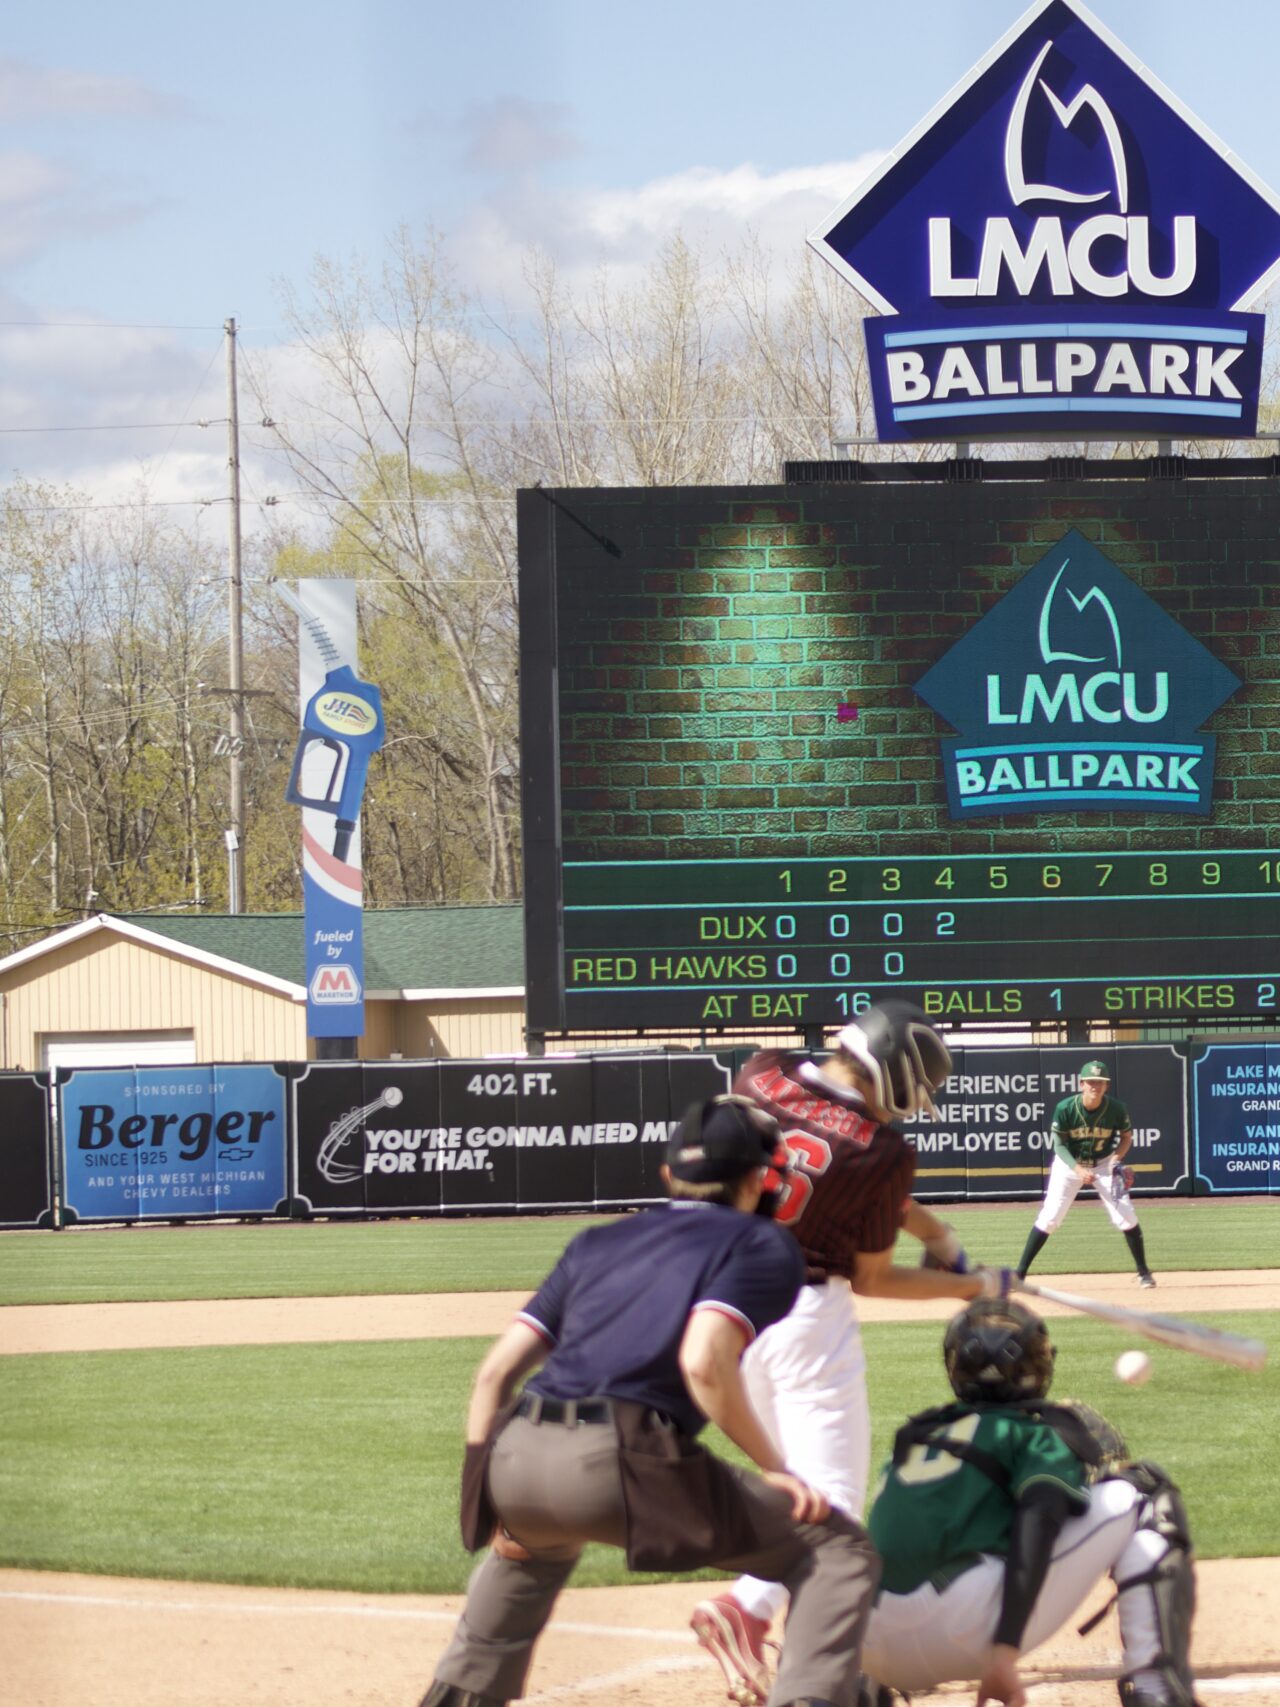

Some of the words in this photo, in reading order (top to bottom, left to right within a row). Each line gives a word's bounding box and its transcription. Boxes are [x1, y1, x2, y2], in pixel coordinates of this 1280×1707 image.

[928, 214, 1197, 297] LMCU
[886, 342, 1244, 403] BALLPARK
[986, 671, 1169, 724] LMCU
[956, 754, 1201, 795] BALLPARK
[779, 870, 792, 893] 1
[829, 869, 847, 892] 2
[882, 869, 901, 891] 3
[935, 867, 955, 889] 4
[990, 866, 1008, 888] 5
[1042, 866, 1061, 888] 6
[1095, 865, 1113, 887] 7
[1149, 864, 1168, 886] 8
[1202, 863, 1221, 885] 9
[314, 929, 354, 945] fueled
[701, 916, 767, 940] DUX
[776, 915, 796, 938] 0
[830, 914, 850, 937] 0
[883, 913, 903, 936] 0
[936, 912, 956, 935] 2
[327, 944, 343, 959] by
[573, 958, 637, 981] RED
[650, 955, 767, 980] HAWKS
[777, 955, 797, 978] 0
[831, 954, 850, 977] 0
[884, 953, 904, 975] 0
[702, 996, 738, 1019] AT
[751, 994, 809, 1018] BAT
[834, 993, 872, 1016] 16
[925, 990, 1022, 1014] BALLS
[1050, 988, 1062, 1012] 1
[1104, 985, 1235, 1010] STRIKES
[1258, 984, 1276, 1007] 2
[467, 1073, 517, 1095] 402
[523, 1072, 557, 1095] FT.
[1226, 1065, 1263, 1078] LAKE
[124, 1083, 204, 1097] SPONSORED
[209, 1083, 226, 1094] BY
[1015, 1102, 1045, 1122] OF
[78, 1104, 276, 1161] Berger
[466, 1125, 566, 1148] GONNA
[571, 1122, 638, 1146] NEED
[84, 1154, 129, 1167] SINCE
[134, 1152, 168, 1166] 1925
[364, 1152, 416, 1174] FOR
[421, 1149, 494, 1172] THAT.
[1226, 1160, 1270, 1171] GRAND
[88, 1176, 114, 1187] AND
[120, 1174, 154, 1186] YOUR
[160, 1172, 195, 1184] WEST
[202, 1171, 265, 1182] MICHIGAN
[124, 1187, 168, 1199] CHEVY
[173, 1184, 231, 1197] DEALERS
